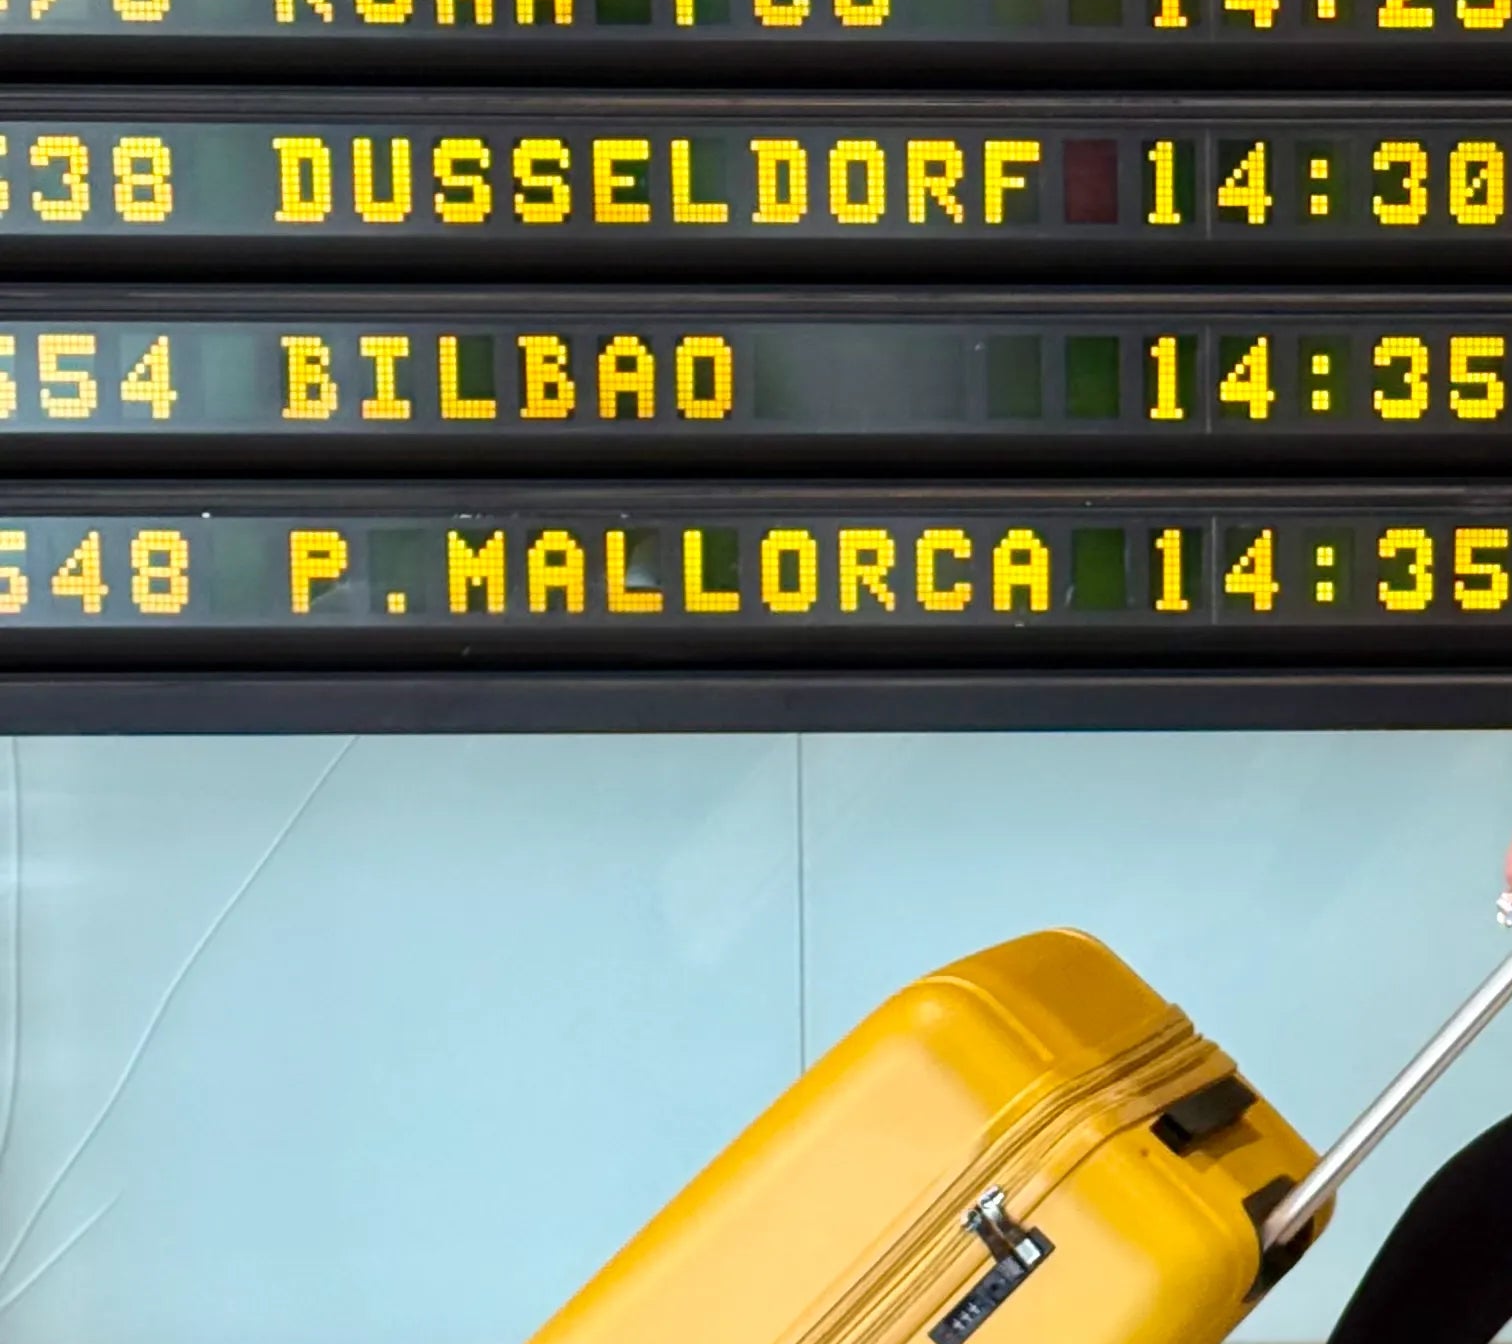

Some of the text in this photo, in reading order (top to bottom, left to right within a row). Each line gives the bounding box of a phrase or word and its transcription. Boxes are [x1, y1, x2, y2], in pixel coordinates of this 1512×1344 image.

[0, 135, 173, 222] 38
[273, 138, 1040, 224] DUSSELDORF
[1149, 142, 1504, 224] 14:30
[0, 334, 1504, 420] 54 BILBAO 14:35
[290, 529, 1049, 614] P.MALLORCA
[1156, 529, 1508, 610] 14:35
